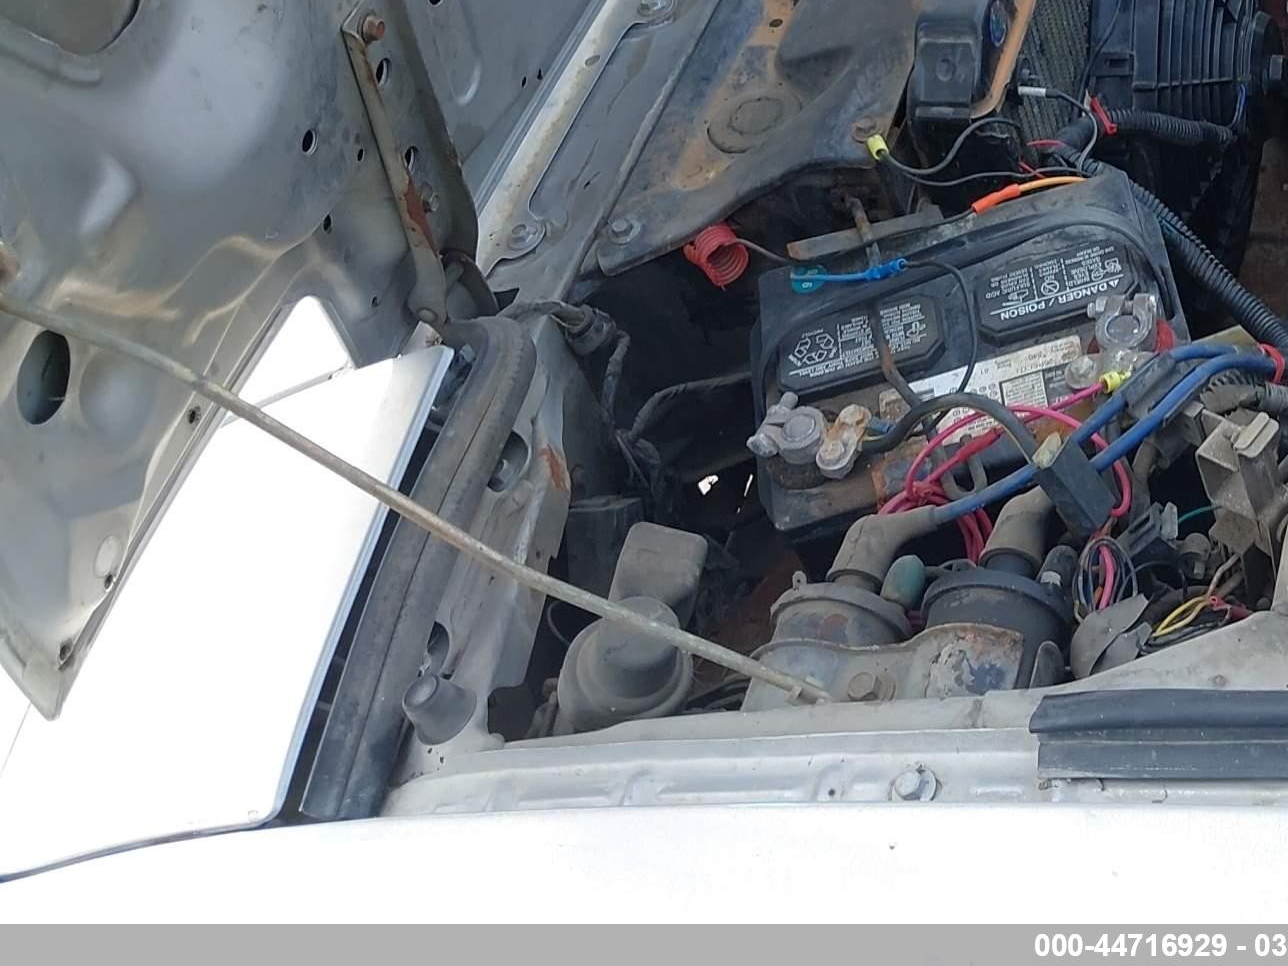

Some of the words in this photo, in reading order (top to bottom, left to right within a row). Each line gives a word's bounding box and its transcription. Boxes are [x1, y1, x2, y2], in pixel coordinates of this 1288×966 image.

[1047, 297, 1055, 306] /
[1057, 281, 1108, 304] DANGER
[999, 300, 1045, 320] POISON
